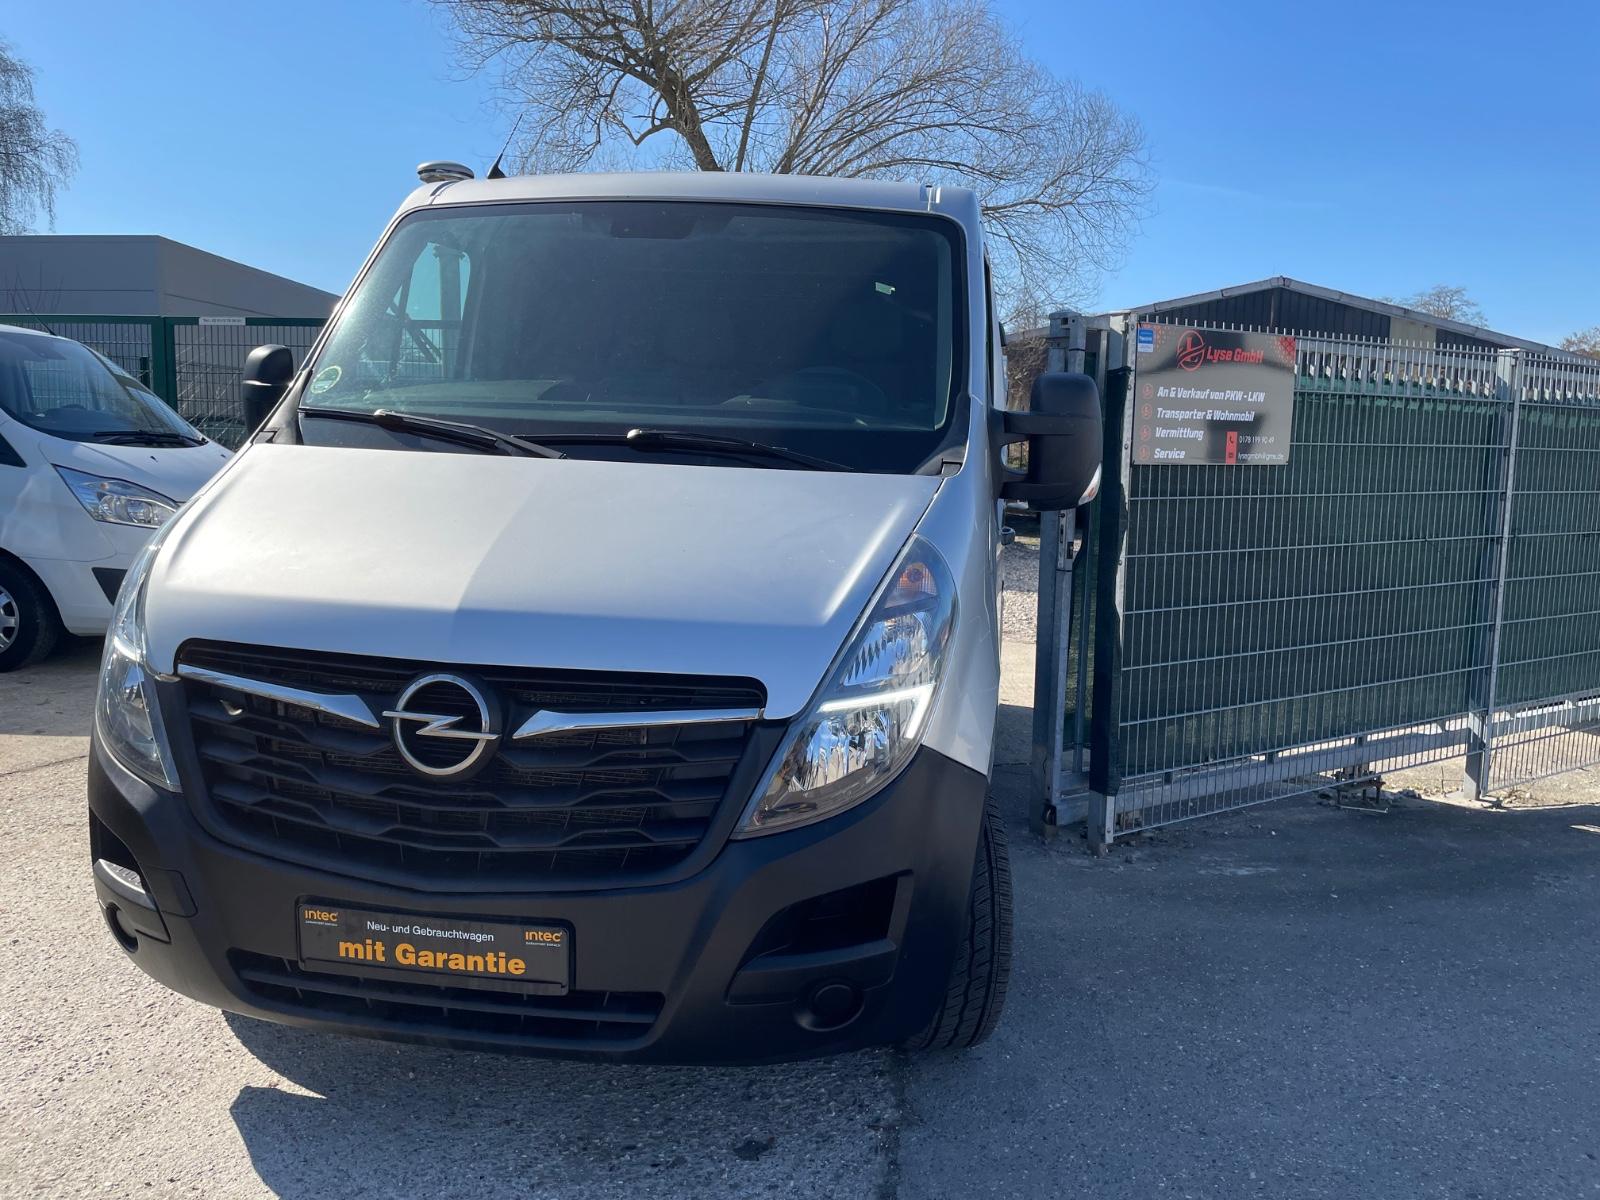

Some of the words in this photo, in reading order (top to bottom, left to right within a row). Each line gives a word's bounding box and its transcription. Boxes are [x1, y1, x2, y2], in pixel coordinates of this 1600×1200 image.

[1206, 346, 1233, 364] Lyse
[1234, 347, 1265, 364] GmbH
[1157, 386, 1170, 398] An
[1170, 387, 1177, 398] &
[1177, 387, 1210, 399] Verkauf
[1210, 391, 1224, 401] von
[1224, 390, 1243, 401] PKW
[1248, 391, 1266, 402] LKW
[1157, 408, 1206, 422] Transporter
[1206, 410, 1212, 420] &
[1213, 410, 1255, 422] Wohnmobil
[1155, 427, 1204, 441] Vermittlung
[1154, 448, 1186, 459] Service
[367, 921, 390, 932] Neu-
[392, 924, 410, 934] und
[412, 925, 494, 942] Gebrauchtwagen
[338, 938, 386, 962] mit
[395, 943, 526, 975] Garantie
